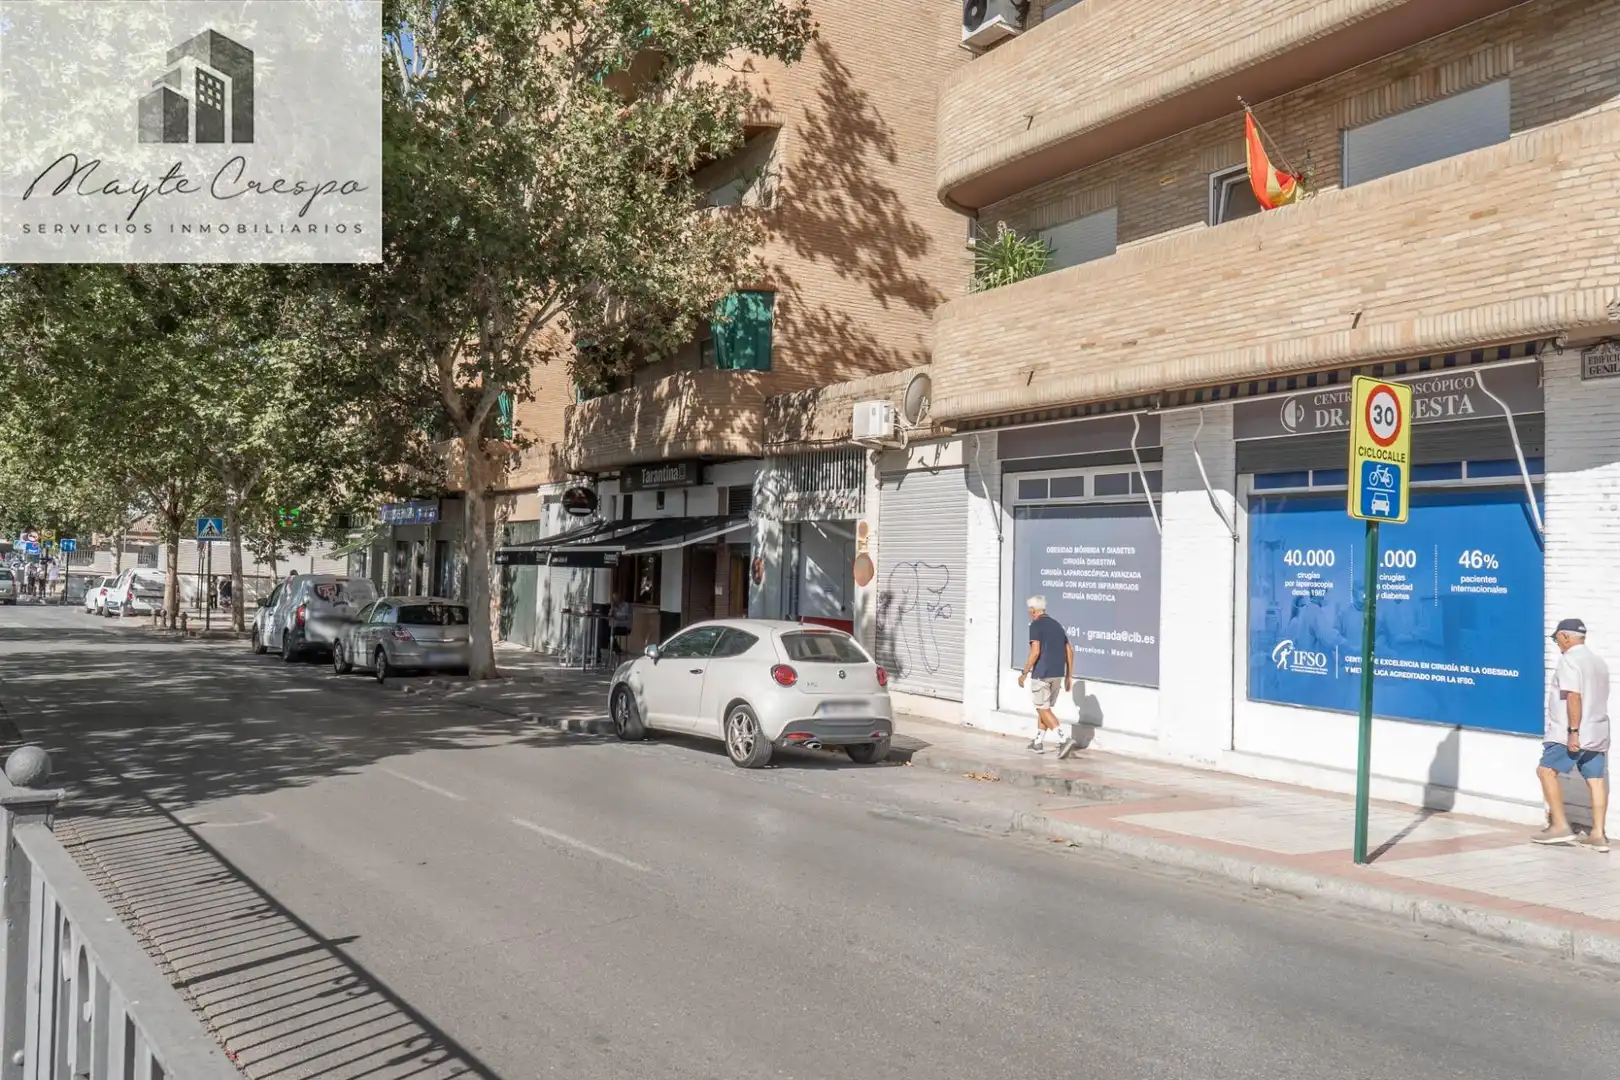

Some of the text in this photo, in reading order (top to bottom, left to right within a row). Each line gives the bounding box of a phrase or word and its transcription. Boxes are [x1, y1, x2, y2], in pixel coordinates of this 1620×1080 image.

[1314, 391, 1352, 405] CENTR
[1315, 393, 1475, 429] DR. ESTA
[1373, 404, 1394, 427] 30
[1358, 445, 1406, 463] CICLOCALLE
[642, 464, 679, 483] Tarantina
[1101, 546, 1106, 554] Y
[1106, 546, 1136, 555] DIABETES
[1063, 556, 1085, 565] CIRUGÍA
[1283, 549, 1335, 567] 40.000
[1379, 550, 1417, 568] .000
[1458, 549, 1499, 569] 46%
[1040, 568, 1142, 579] CIRUGÍA LAPAROSCÓPICA AVANZADA
[1297, 571, 1321, 580] cirugías
[1379, 573, 1406, 582] cirugías
[1460, 575, 1497, 584] pacientes
[1042, 579, 1140, 591] CIRUGÍA CON RAYOS INFRARROJOS
[1382, 583, 1413, 591] obesidad
[1450, 584, 1508, 594] internacionales
[1062, 591, 1116, 602] CIRUGÍA ROBÓTICA
[1381, 591, 1410, 600] diabetes
[1075, 645, 1133, 658] Barcelona Madrid
[1293, 650, 1327, 668] IFSO
[1380, 658, 1419, 669] EXCELENCIA
[1420, 662, 1430, 670] EN
[1431, 662, 1459, 672] CIRUGÍA
[1481, 667, 1519, 678] OBESIDAD
[1344, 666, 1350, 674] Y
[1389, 670, 1430, 681] ACREDITADO
[1431, 674, 1446, 682] POR
[1446, 676, 1456, 684] LA
